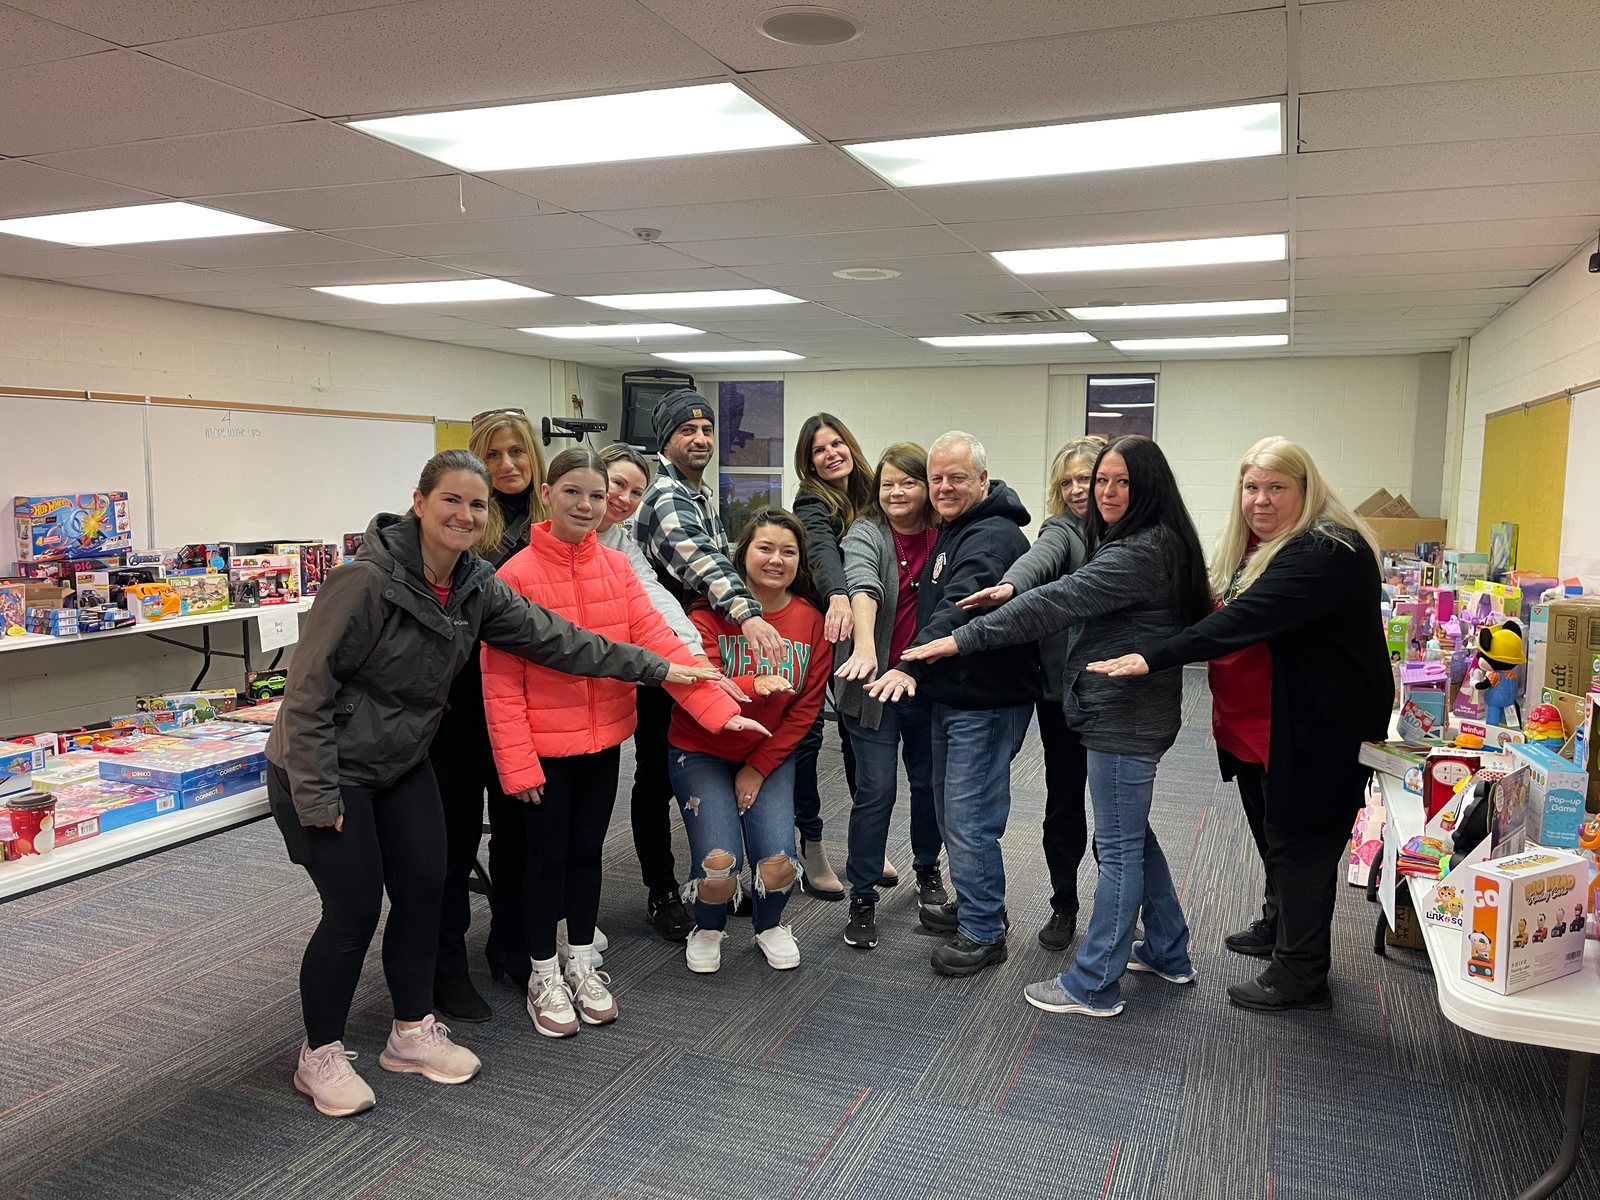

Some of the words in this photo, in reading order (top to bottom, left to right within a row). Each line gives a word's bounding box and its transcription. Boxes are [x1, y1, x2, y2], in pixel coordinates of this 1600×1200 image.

[1568, 619, 1576, 641] 20169
[1549, 795, 1581, 806] Pop-up
[1551, 804, 1577, 813] Game
